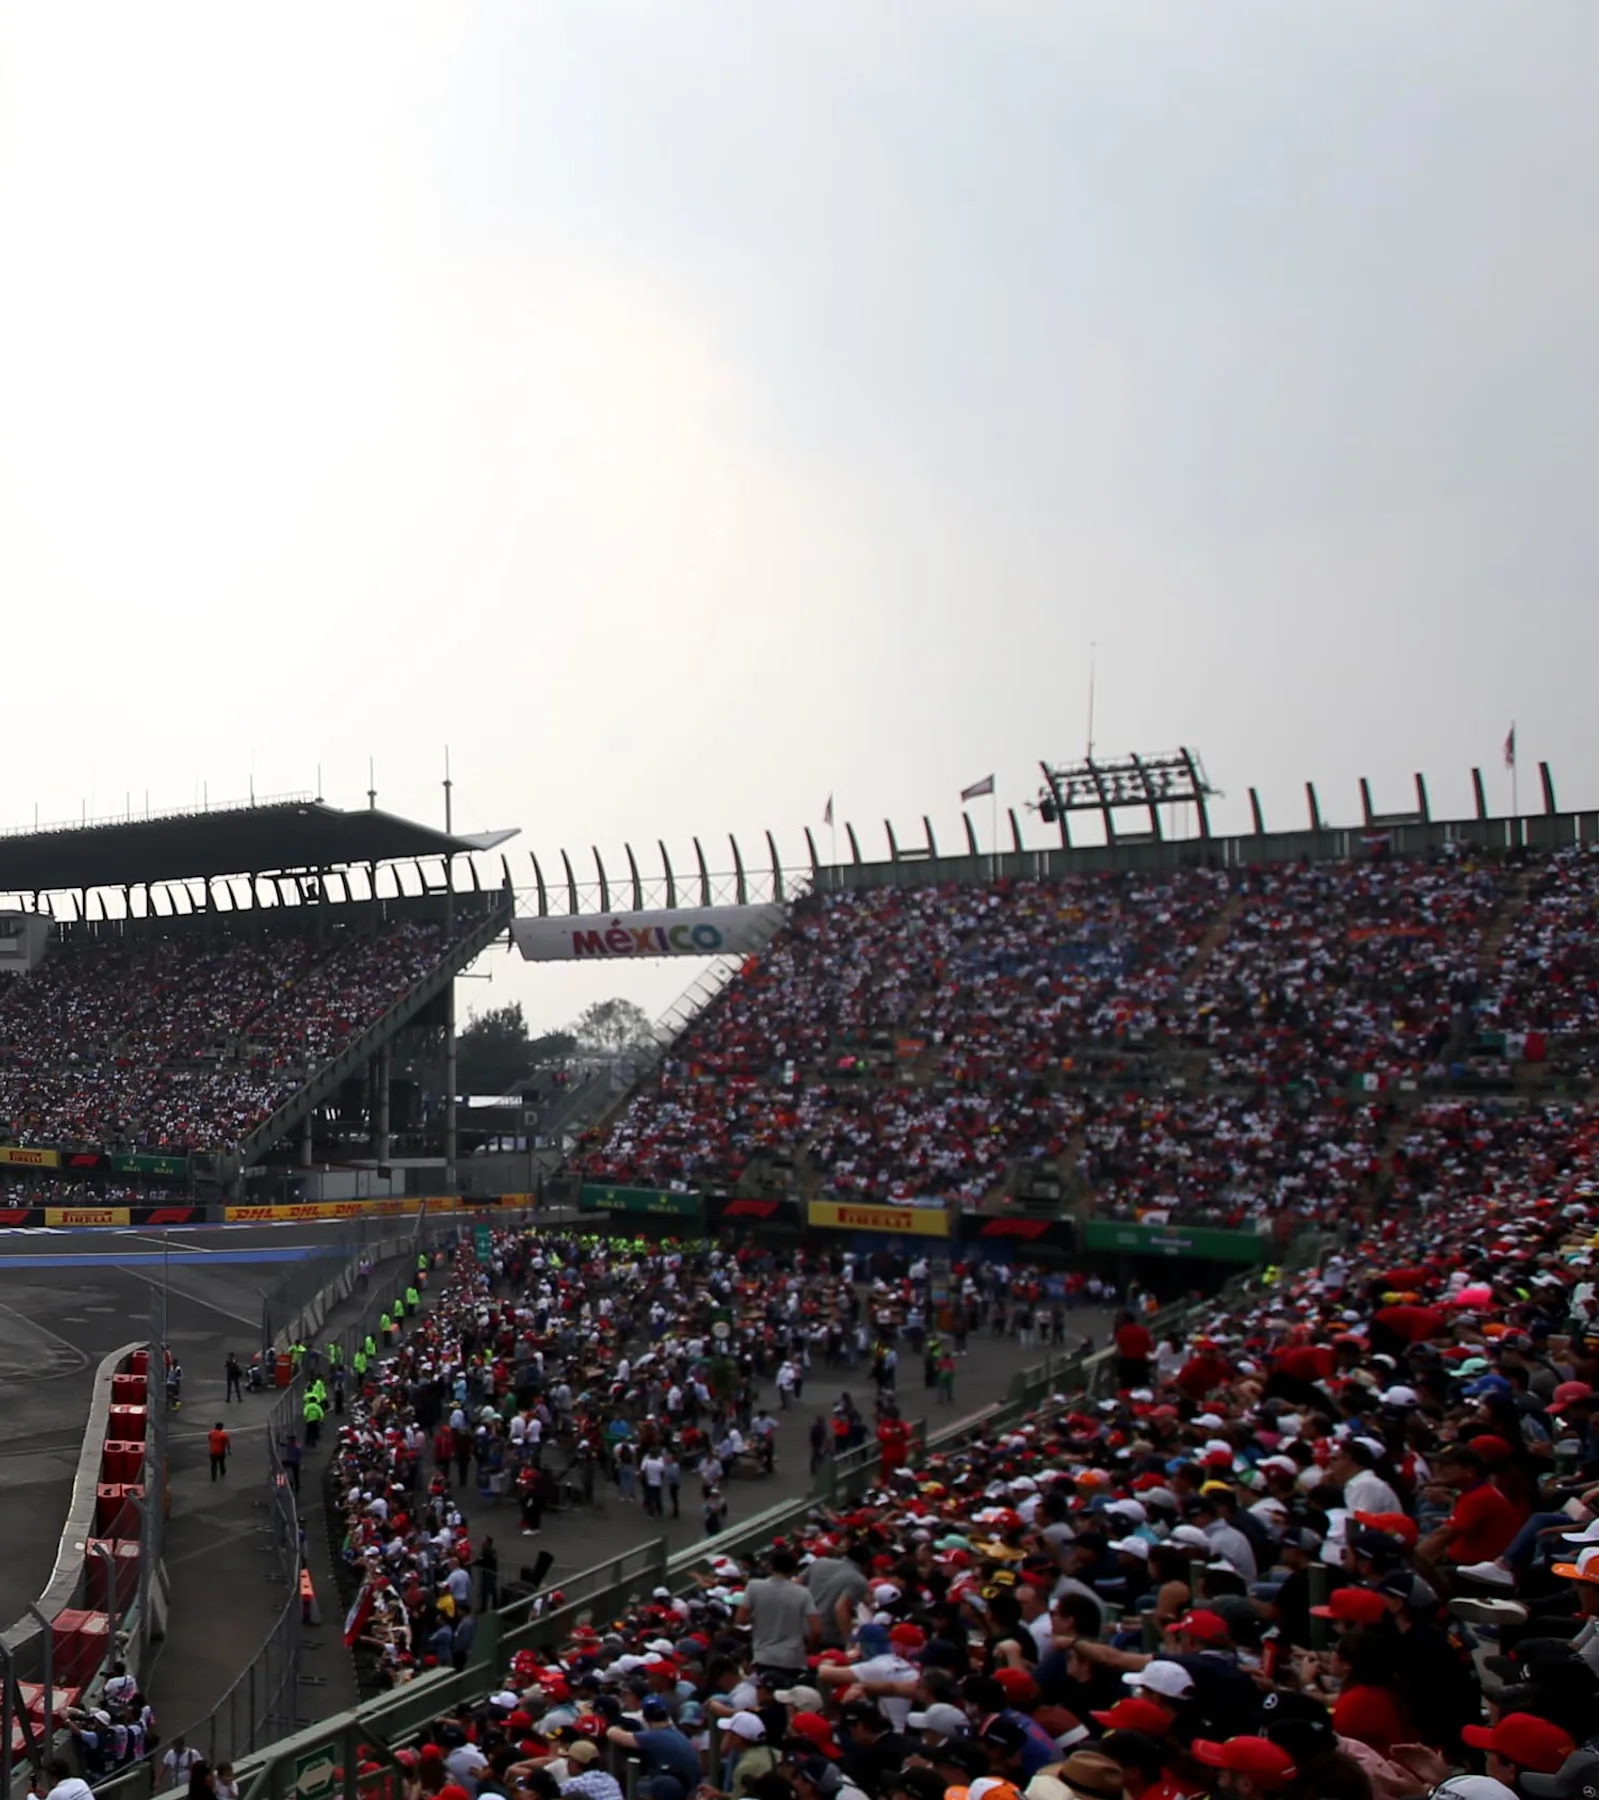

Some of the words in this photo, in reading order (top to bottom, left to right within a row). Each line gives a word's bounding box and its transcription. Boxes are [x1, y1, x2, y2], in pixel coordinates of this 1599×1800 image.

[9, 1151, 42, 1163] PIRELLI
[62, 1211, 113, 1224] PIRELLI
[235, 1208, 274, 1219] DHL
[289, 1206, 320, 1217] DHL
[334, 1203, 364, 1214] DHL
